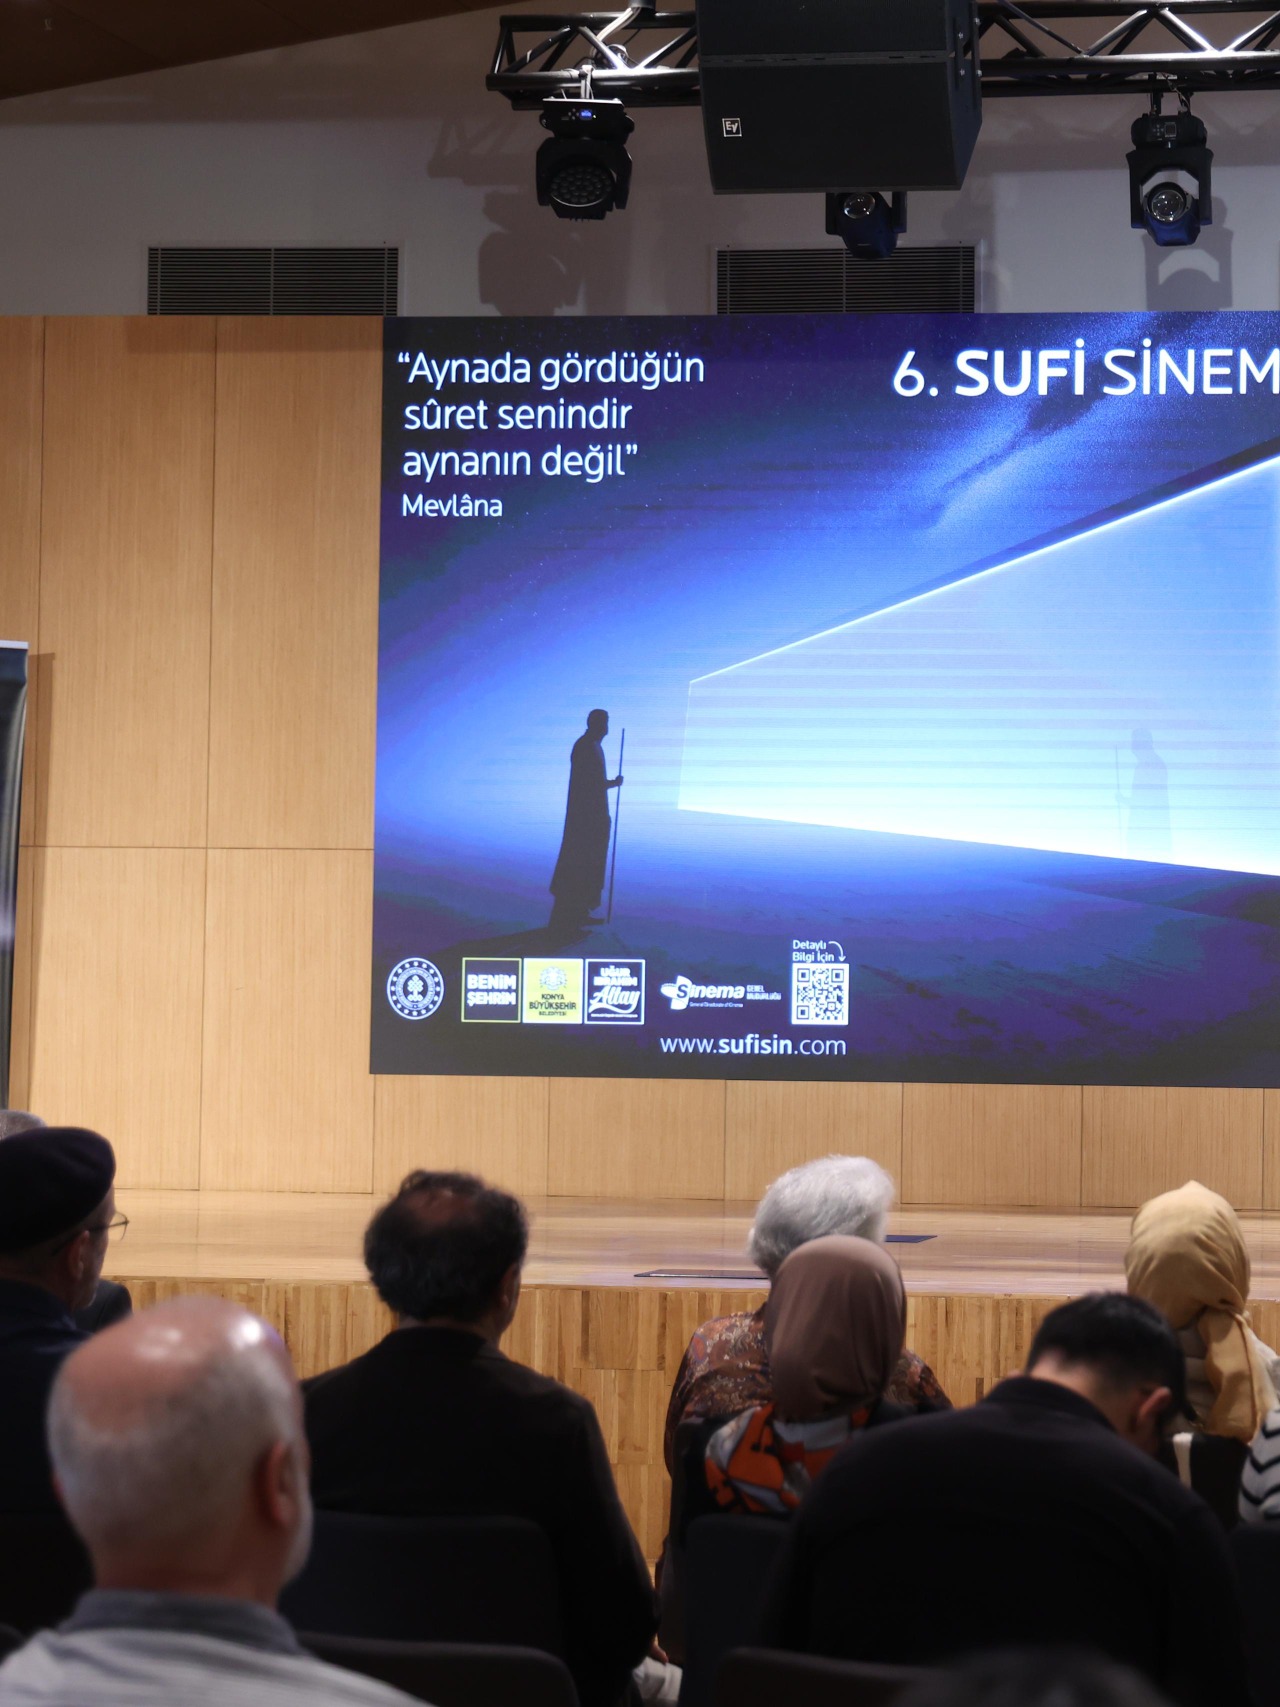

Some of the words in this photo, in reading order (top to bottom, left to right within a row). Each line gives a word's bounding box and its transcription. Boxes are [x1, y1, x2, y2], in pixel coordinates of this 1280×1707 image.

[540, 351, 705, 391] gördüğün
[893, 350, 938, 397] 6.
[955, 338, 1085, 396] SUFİ
[404, 398, 489, 430] sûret
[498, 398, 633, 430] senindir
[403, 450, 531, 483] aynanın
[402, 494, 503, 517] Mevlâna
[792, 939, 827, 951] Detaylı
[792, 951, 815, 963] Bilgi
[817, 951, 835, 963] İçin
[660, 1034, 847, 1055] www.sufisin.com
